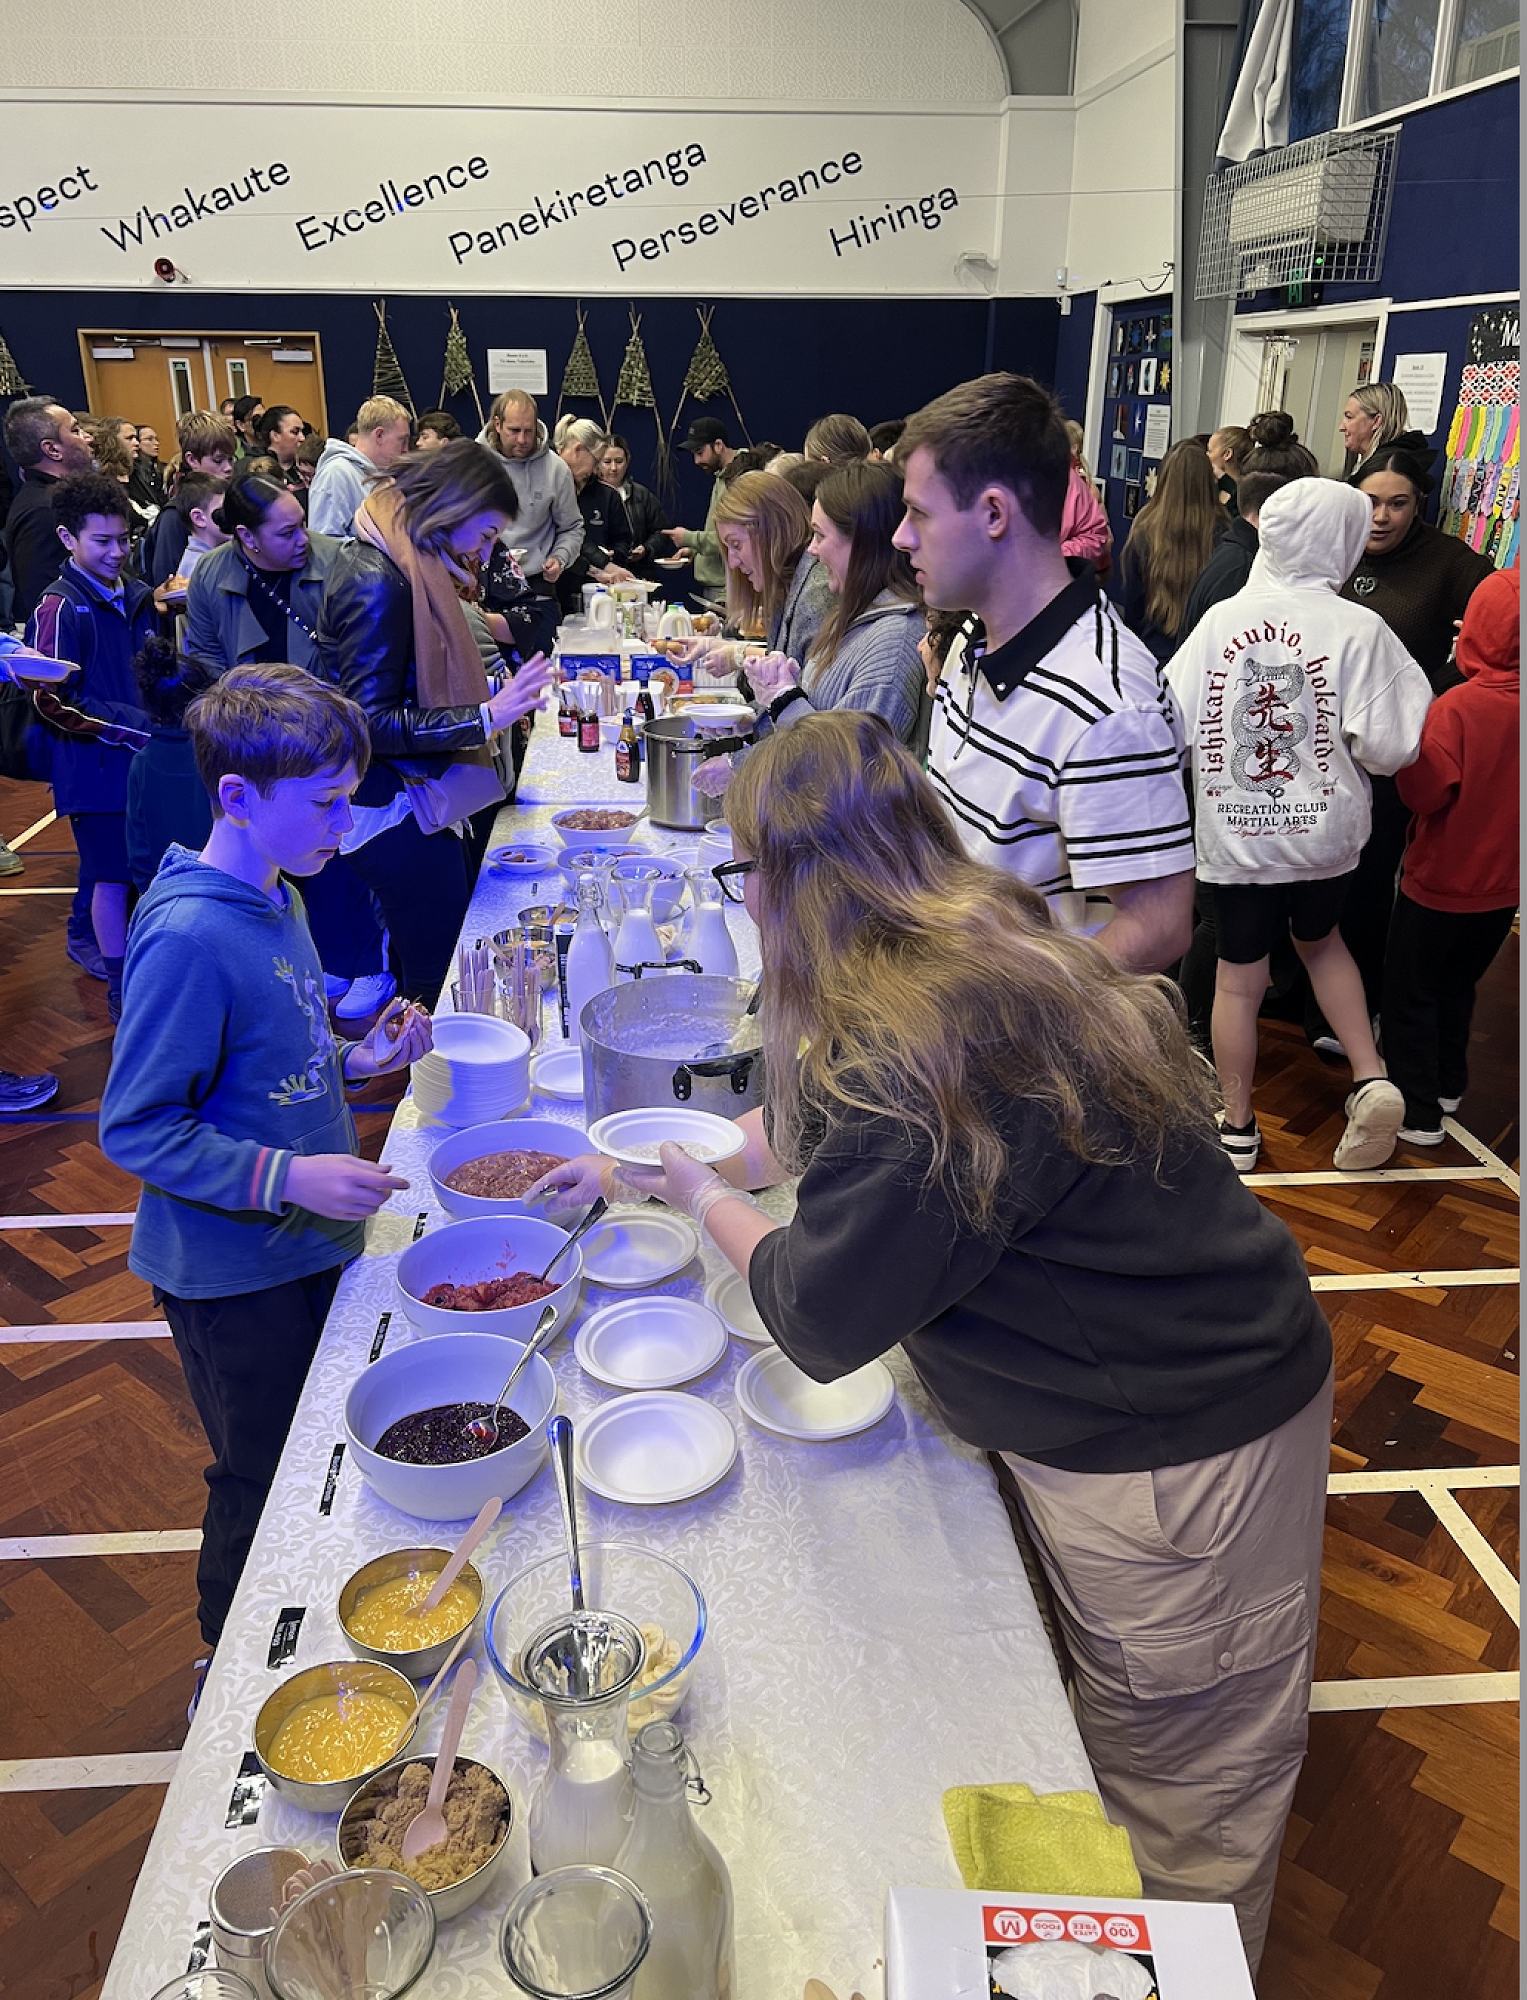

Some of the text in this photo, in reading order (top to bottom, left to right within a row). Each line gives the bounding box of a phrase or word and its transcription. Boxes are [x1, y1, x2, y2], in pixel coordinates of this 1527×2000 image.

[0, 165, 99, 233] spect
[100, 161, 291, 253] Whakaute
[295, 156, 490, 252] Excellence
[447, 142, 707, 265] Panekiretanga
[612, 151, 863, 272] Perseverance
[829, 187, 959, 257] Hiringa
[1199, 669, 1229, 774] ishikari
[1248, 682, 1295, 783] 先生
[1217, 801, 1328, 815] RECREATION CLUB
[1226, 814, 1318, 827] MARTIAL ARTS
[1001, 1920, 1021, 1936] M
[1034, 1922, 1061, 1930] FOOD
[1073, 1922, 1097, 1931] FREE
[1109, 1927, 1135, 1937] 100
